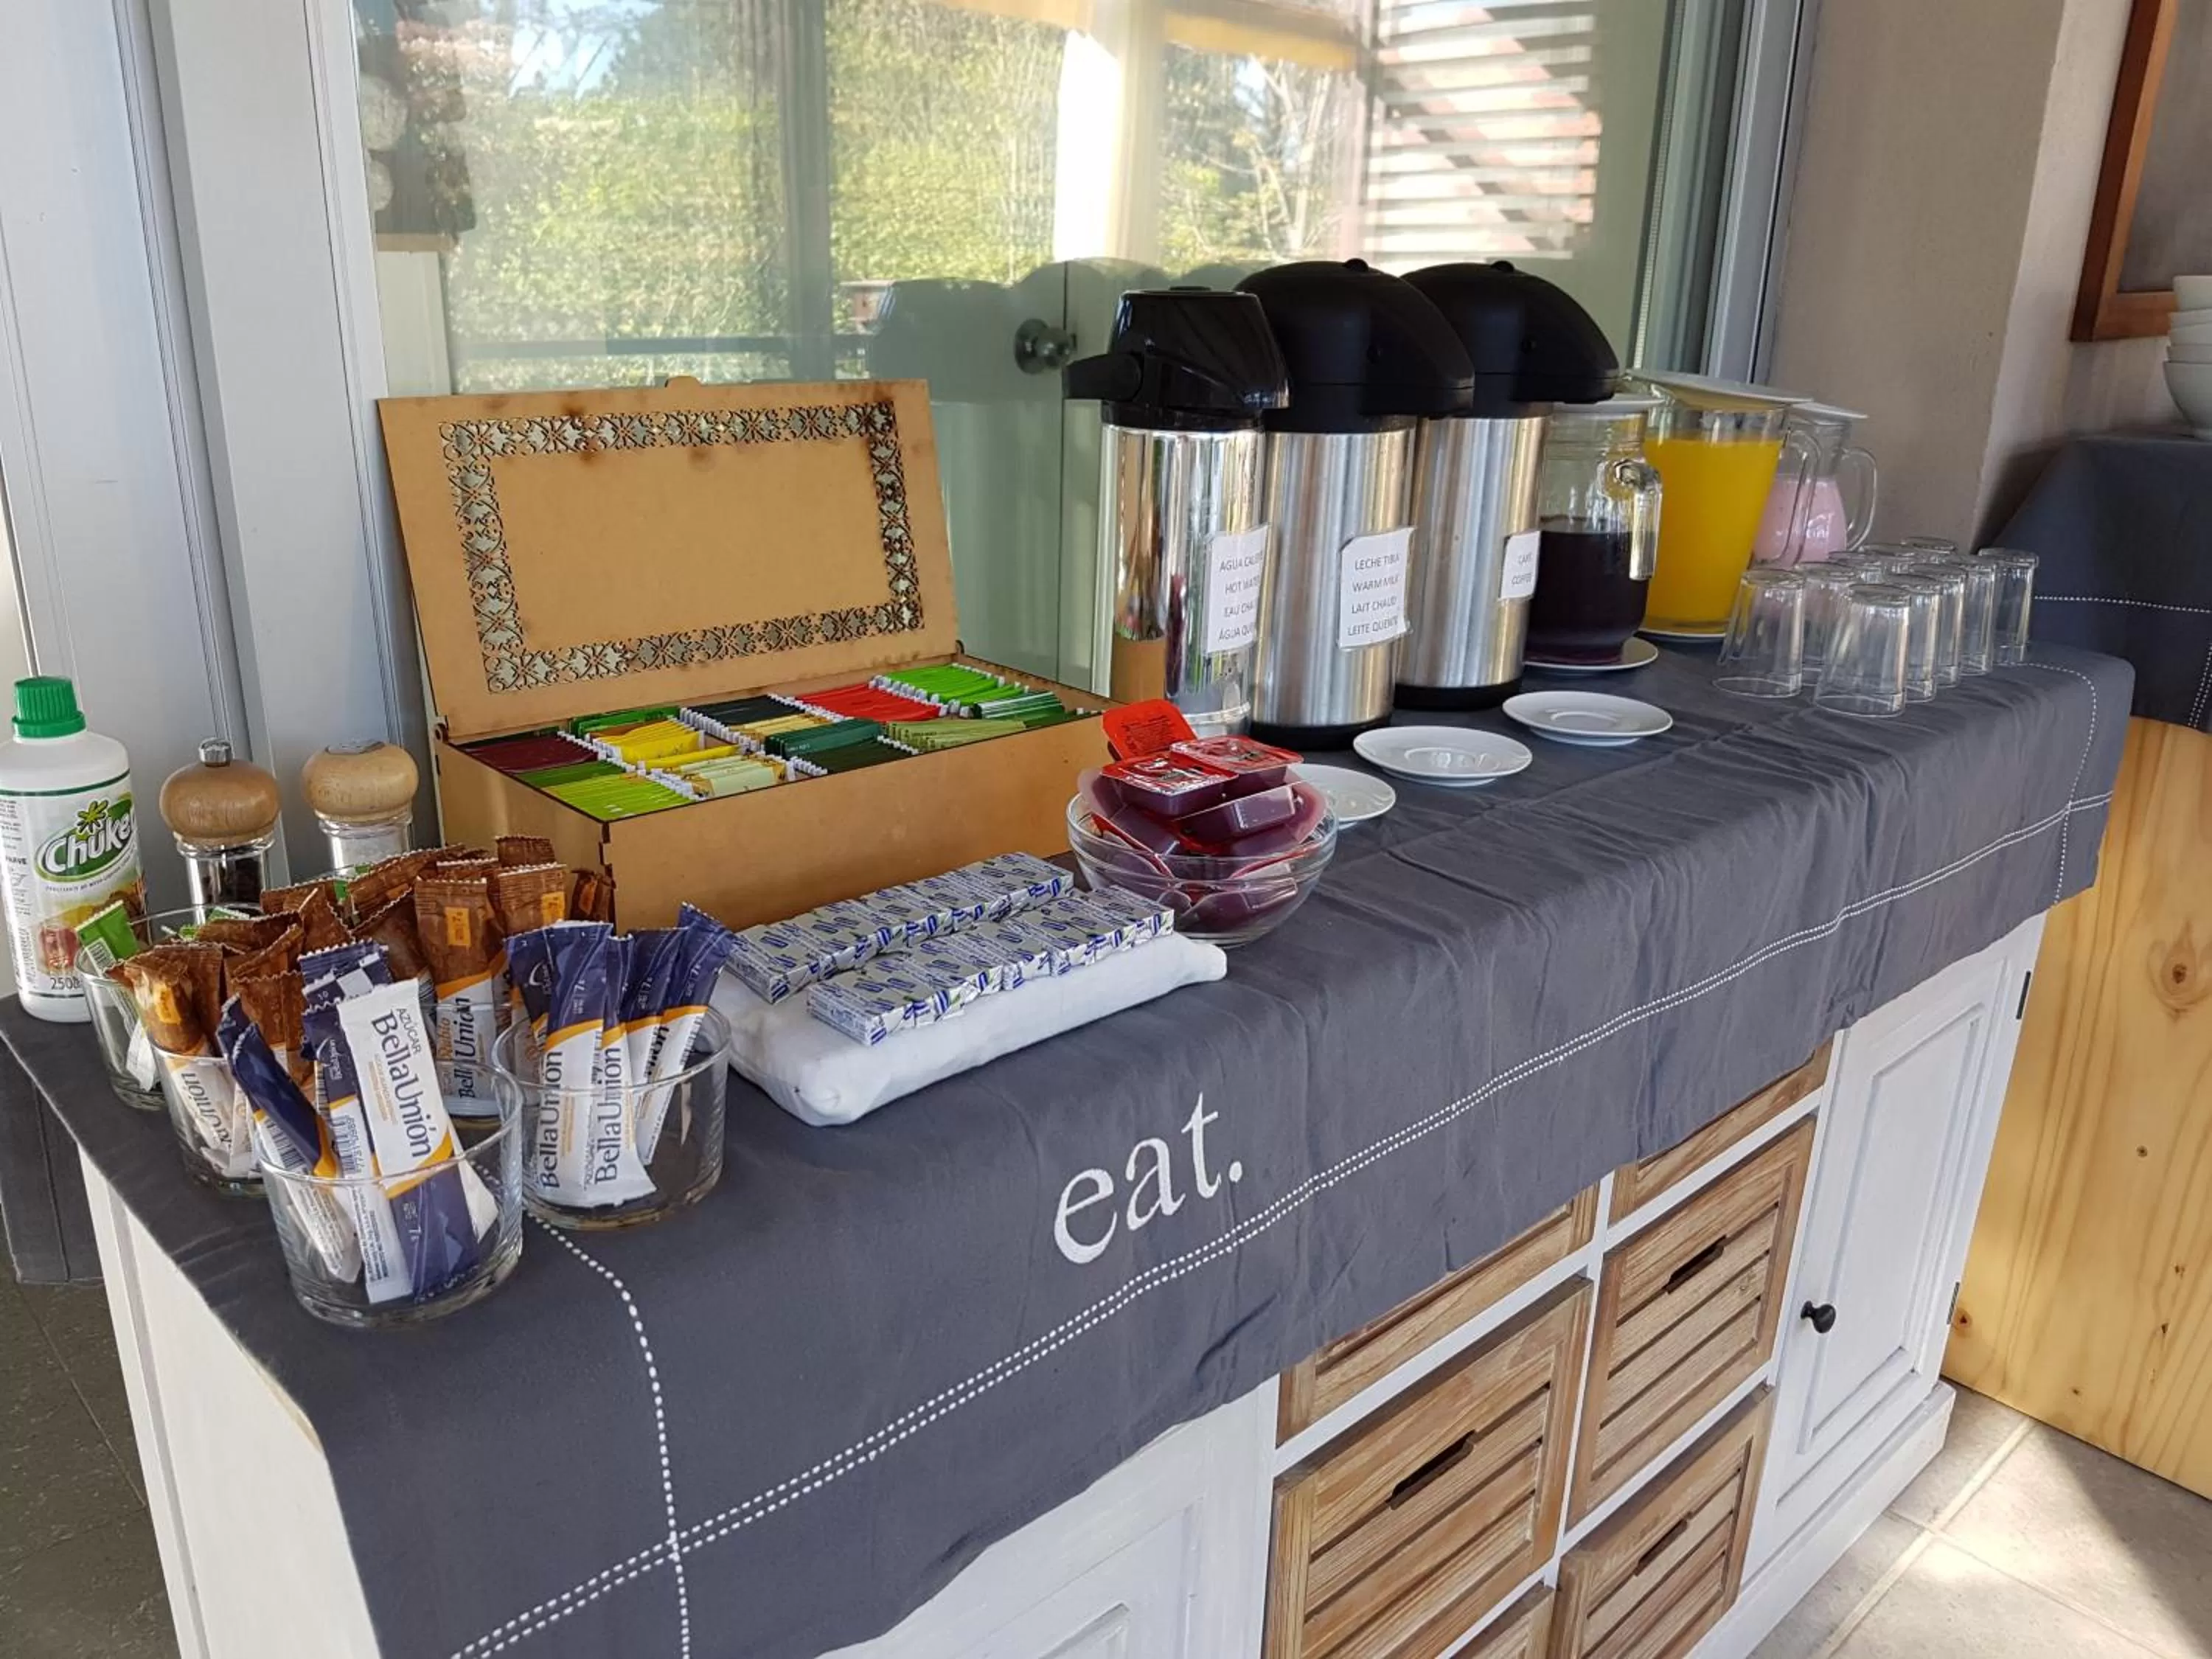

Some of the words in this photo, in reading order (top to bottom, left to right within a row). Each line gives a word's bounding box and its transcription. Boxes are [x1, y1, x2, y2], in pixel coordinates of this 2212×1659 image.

[1354, 557, 1381, 570] LECHE
[1352, 577, 1382, 592] WARM
[1352, 601, 1371, 614] LAIT
[396, 1007, 422, 1054] AZÚCAR
[371, 1009, 437, 1158] BellaUnión
[1054, 1091, 1243, 1265] eat.
